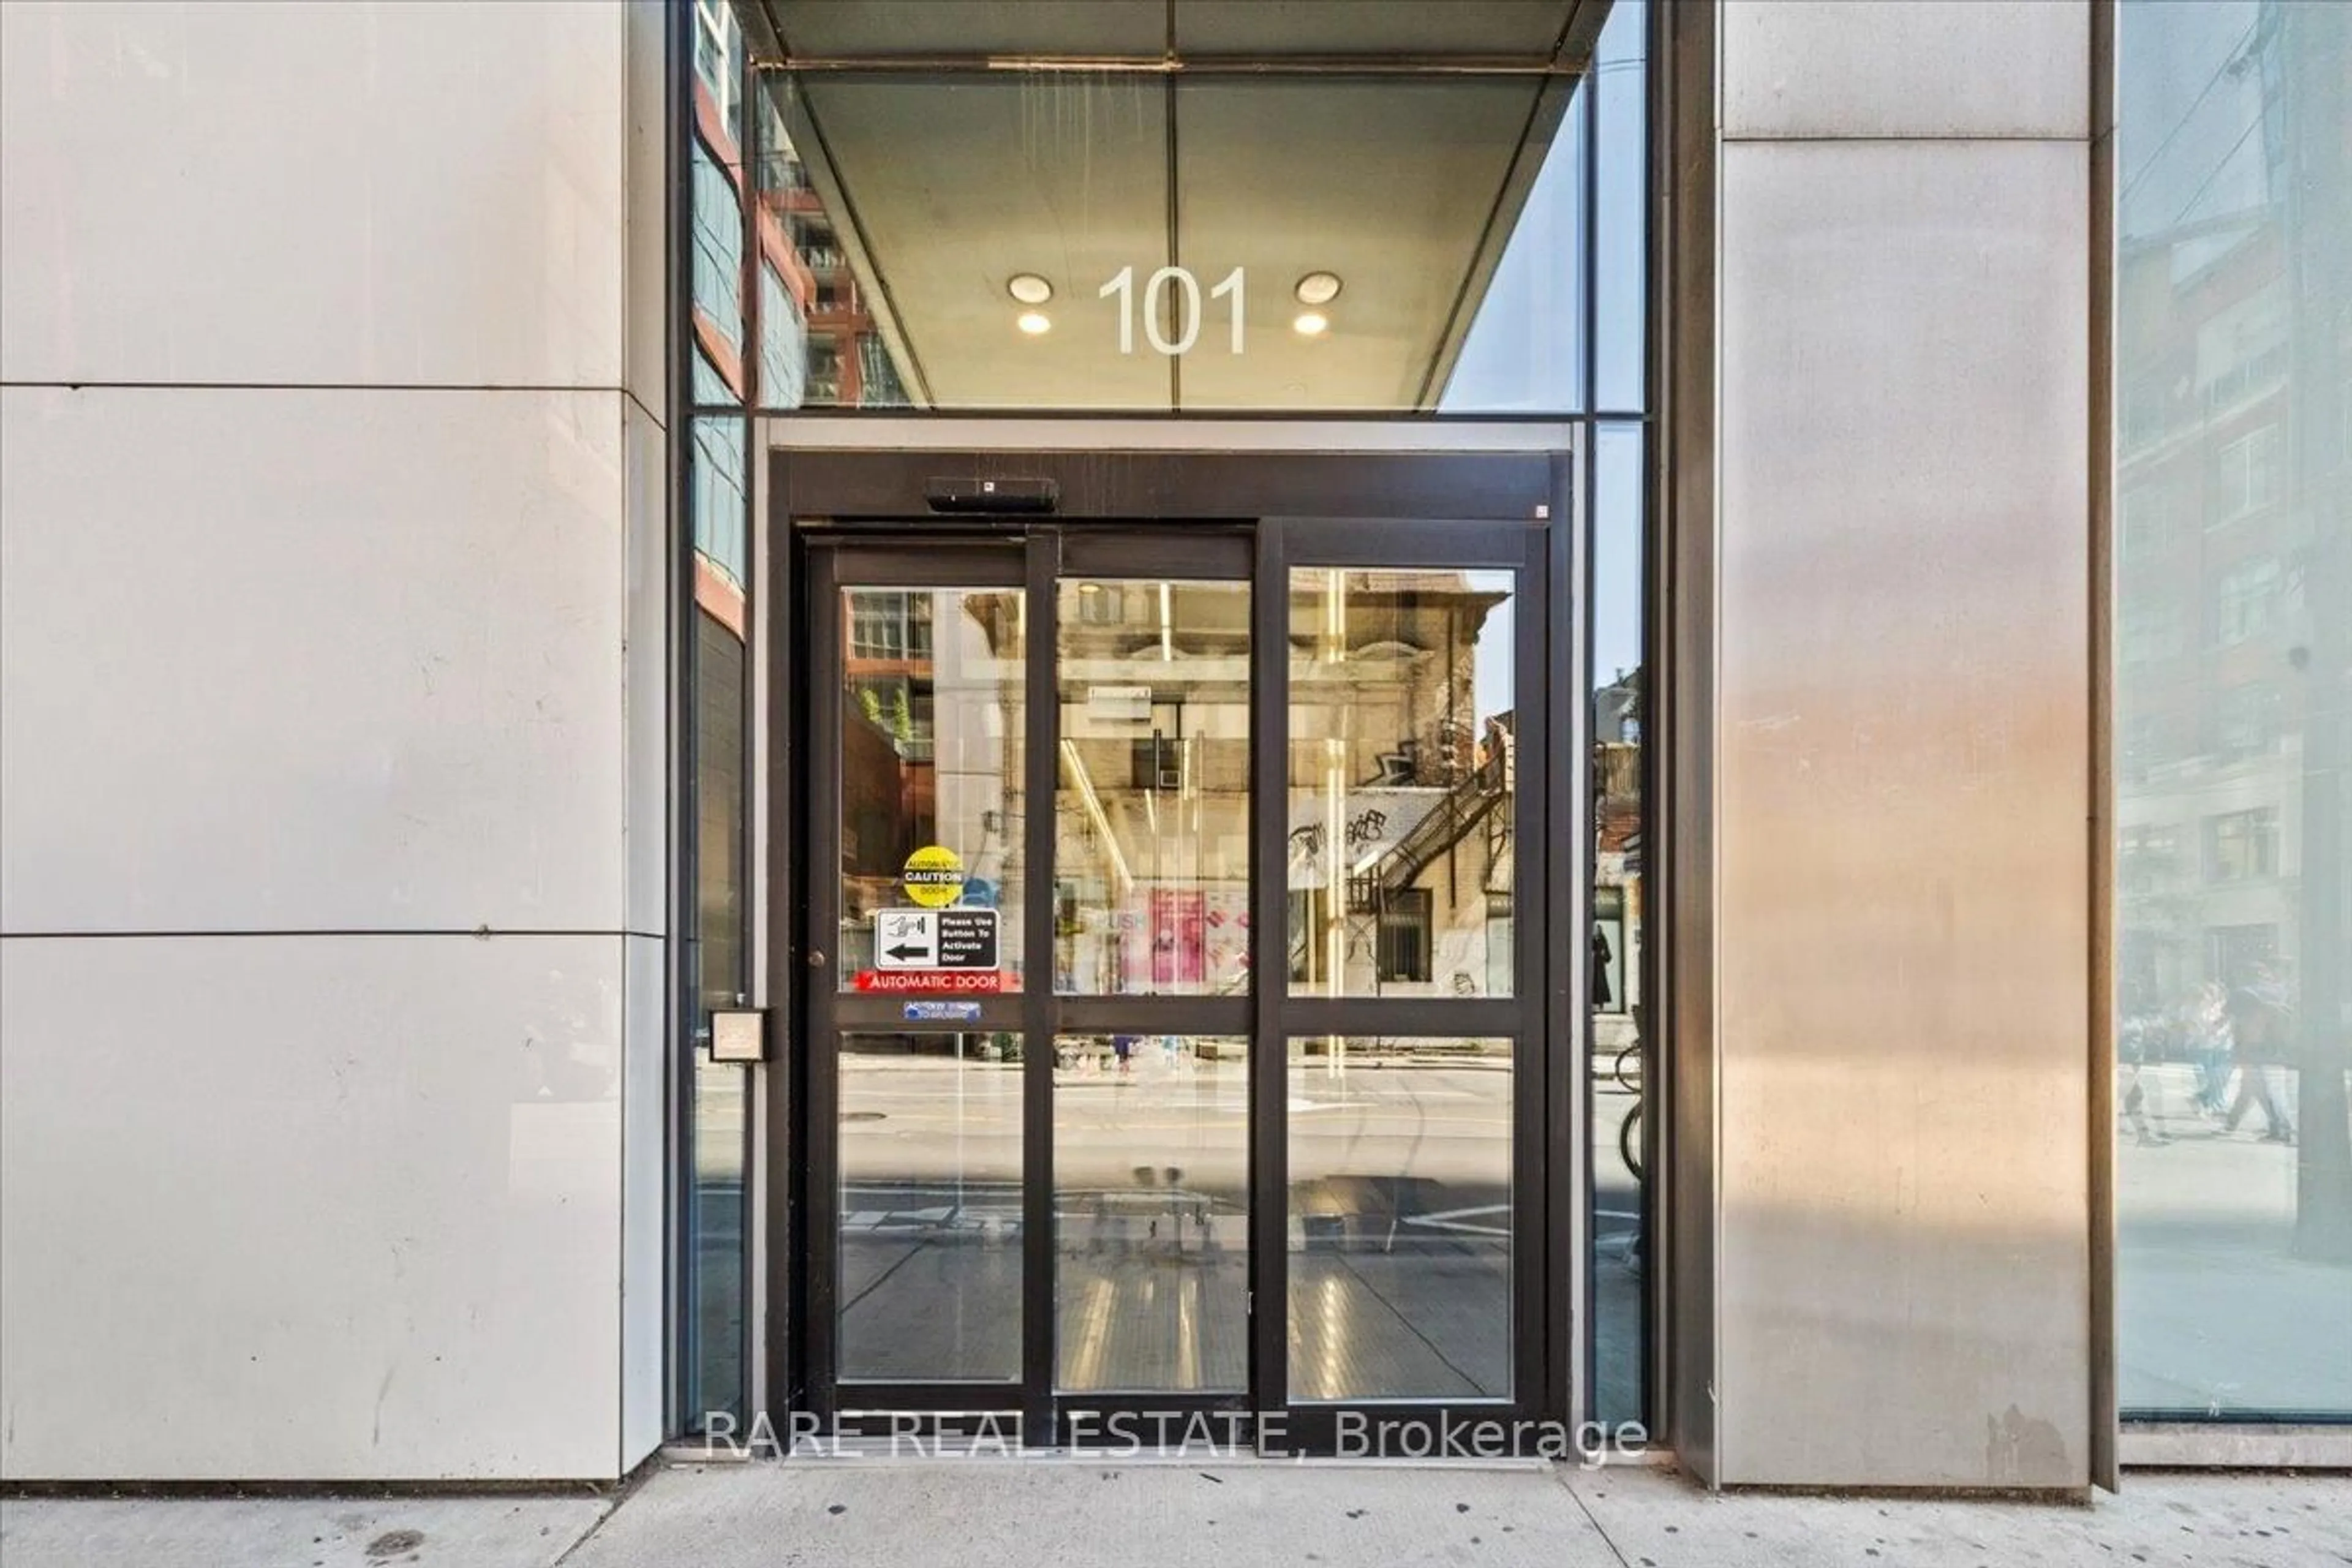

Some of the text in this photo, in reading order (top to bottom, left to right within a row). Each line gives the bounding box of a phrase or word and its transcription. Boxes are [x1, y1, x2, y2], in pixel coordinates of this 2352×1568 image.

[1099, 266, 1244, 356] 101
[905, 872, 962, 881] CAUTION
[941, 917, 993, 926] Please Use
[941, 929, 990, 938] Button To
[942, 941, 982, 950] Activate
[941, 953, 966, 962] Door
[870, 975, 998, 989] AUTOMATIC DOOR
